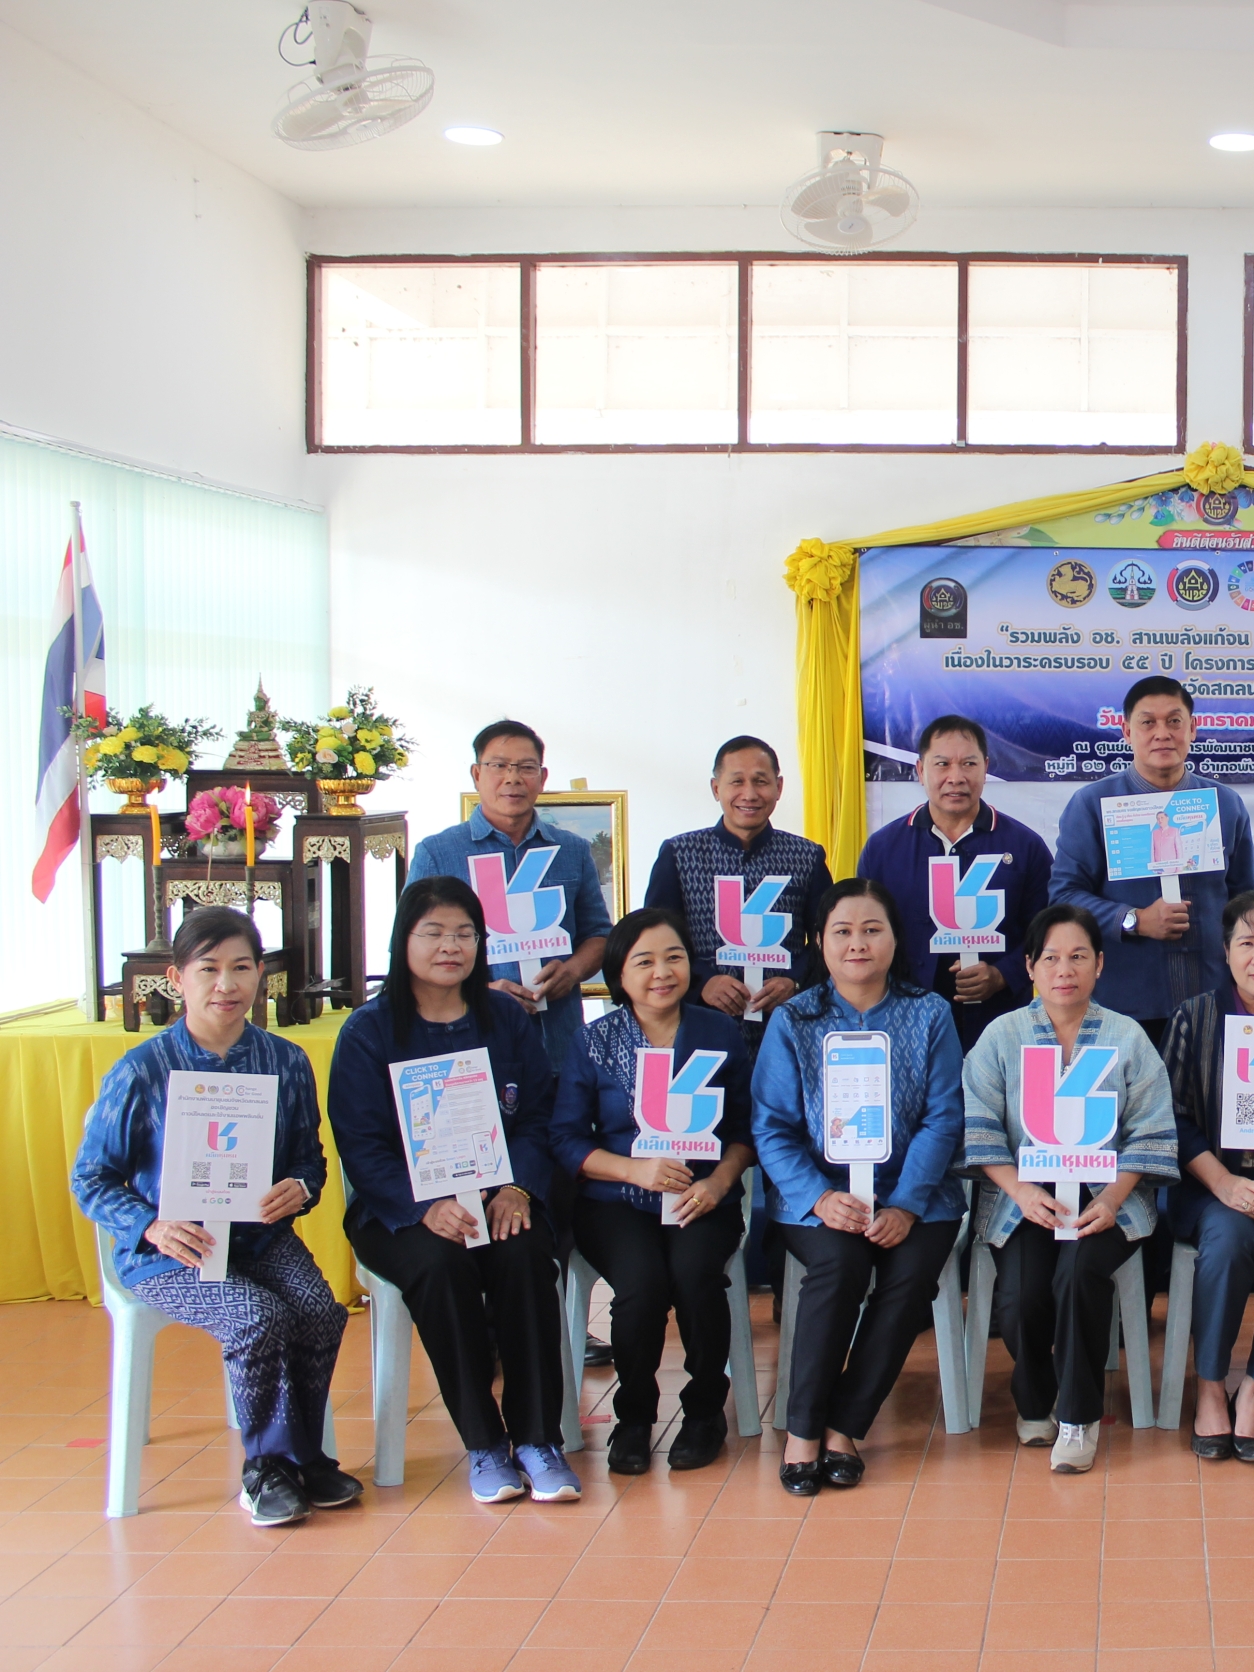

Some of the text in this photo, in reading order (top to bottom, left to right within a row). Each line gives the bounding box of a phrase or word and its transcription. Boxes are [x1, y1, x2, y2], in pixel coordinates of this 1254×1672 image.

[999, 625, 1081, 644] “รวมพลัง
[1092, 631, 1121, 645] อช.
[1132, 626, 1250, 646] สานพลังแก้จน
[944, 646, 1110, 670] เนื่องในวาระครบรอบ
[1121, 653, 1149, 670] ๕๕
[1160, 651, 1173, 670] ปี
[1074, 742, 1089, 753] ณ
[1045, 755, 1076, 774] หมู่ที่
[1082, 758, 1105, 772] ๑๒
[1176, 804, 1210, 812] CONNECT
[933, 932, 1000, 948] คลิกชุมชน
[718, 948, 786, 965] คลิกชุมชน
[405, 1066, 427, 1075] CLICK
[411, 1070, 447, 1081] CONNECT
[637, 1135, 716, 1155] คลิกชุมชน
[1021, 1149, 1116, 1173] คลิกชุมชน
